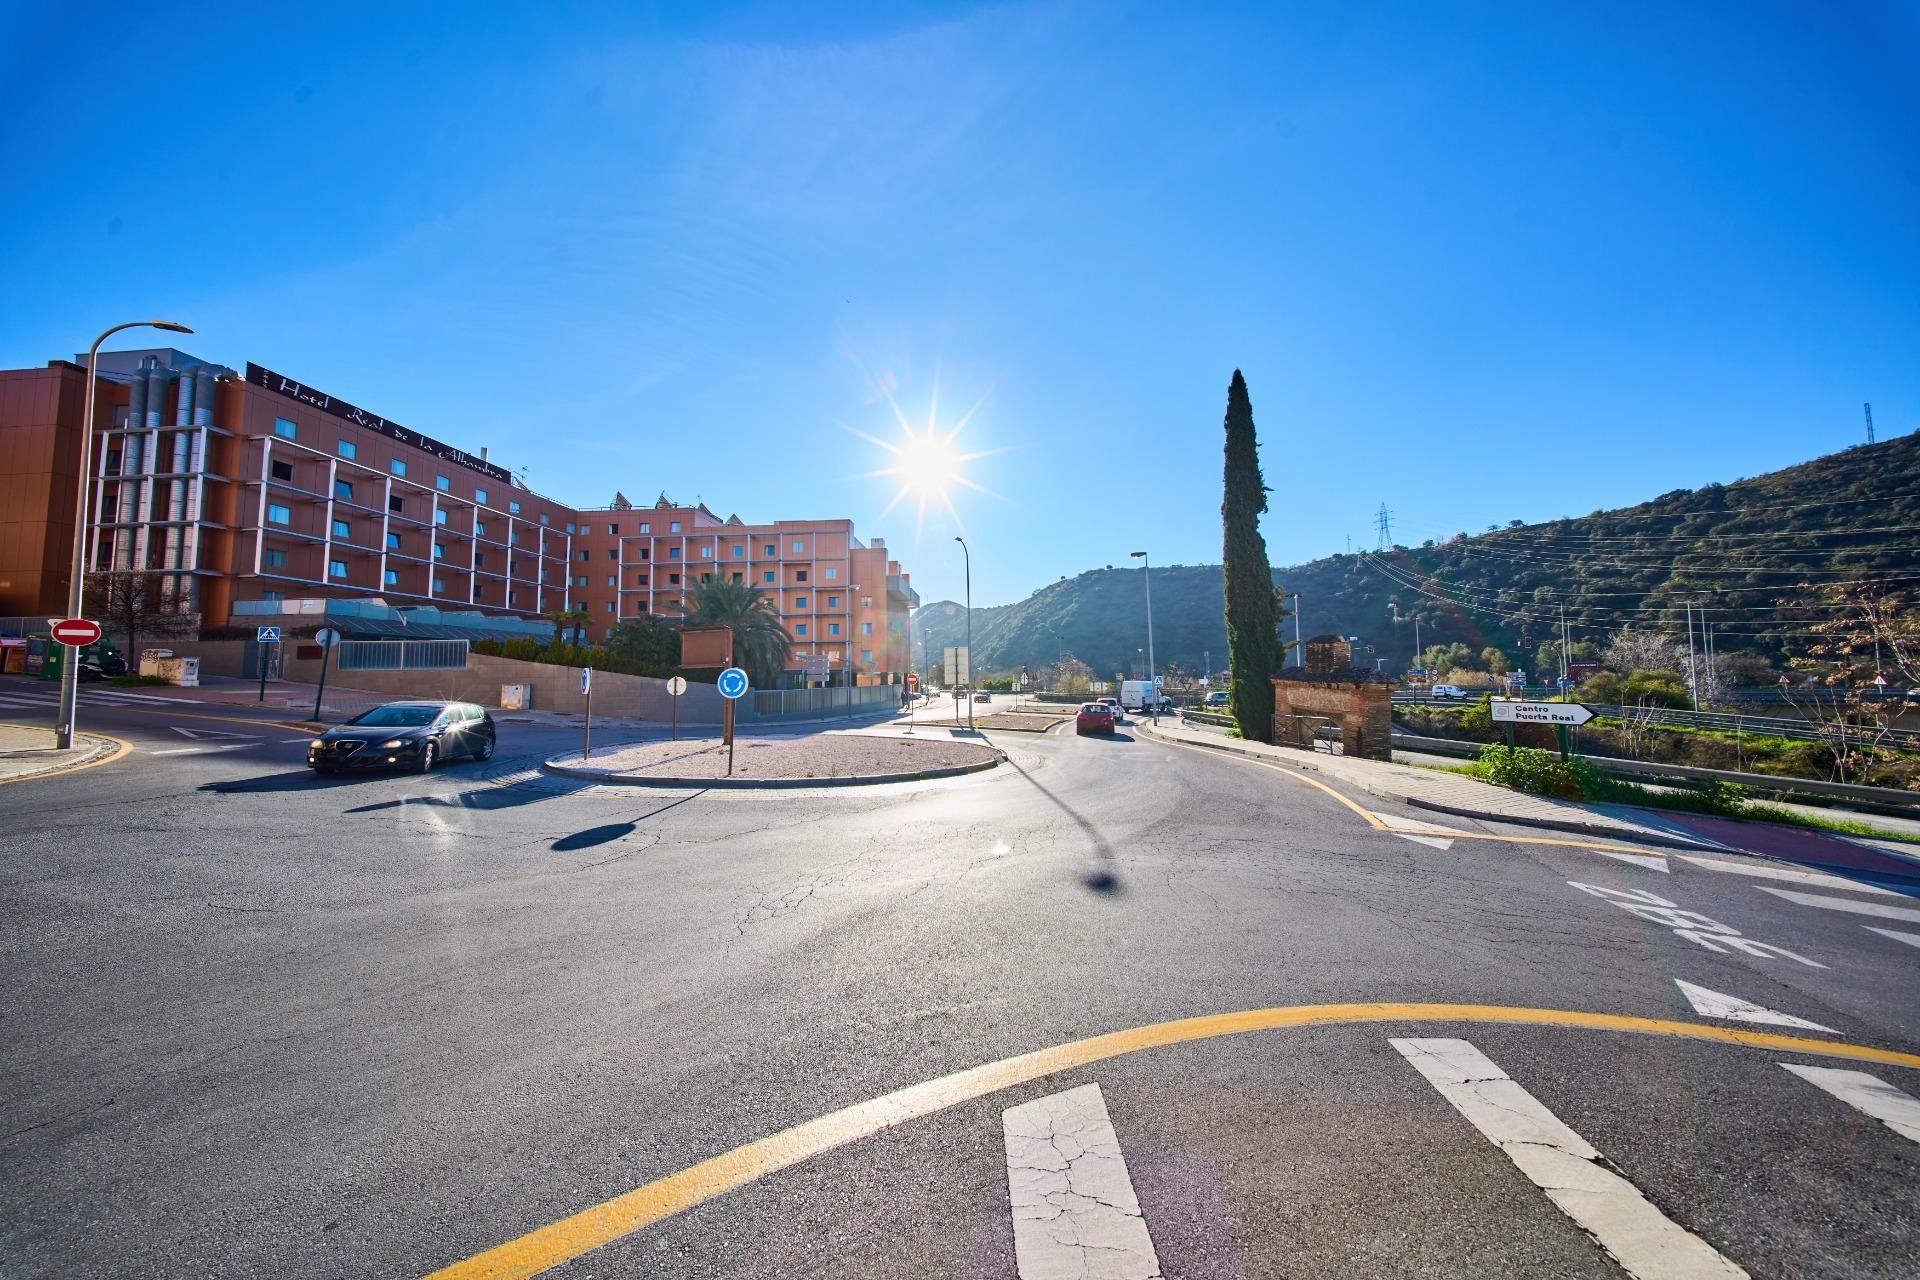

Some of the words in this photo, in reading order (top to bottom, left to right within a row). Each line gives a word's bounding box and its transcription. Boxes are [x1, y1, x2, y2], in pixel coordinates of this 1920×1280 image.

[280, 378, 329, 409] Hotel
[346, 407, 384, 431] Real
[395, 429, 408, 441] de
[420, 436, 433, 451] la
[438, 449, 503, 479] Alhambra
[1515, 705, 1549, 713] Centro
[1515, 712, 1548, 721] Puerta
[1551, 714, 1575, 722] Real
